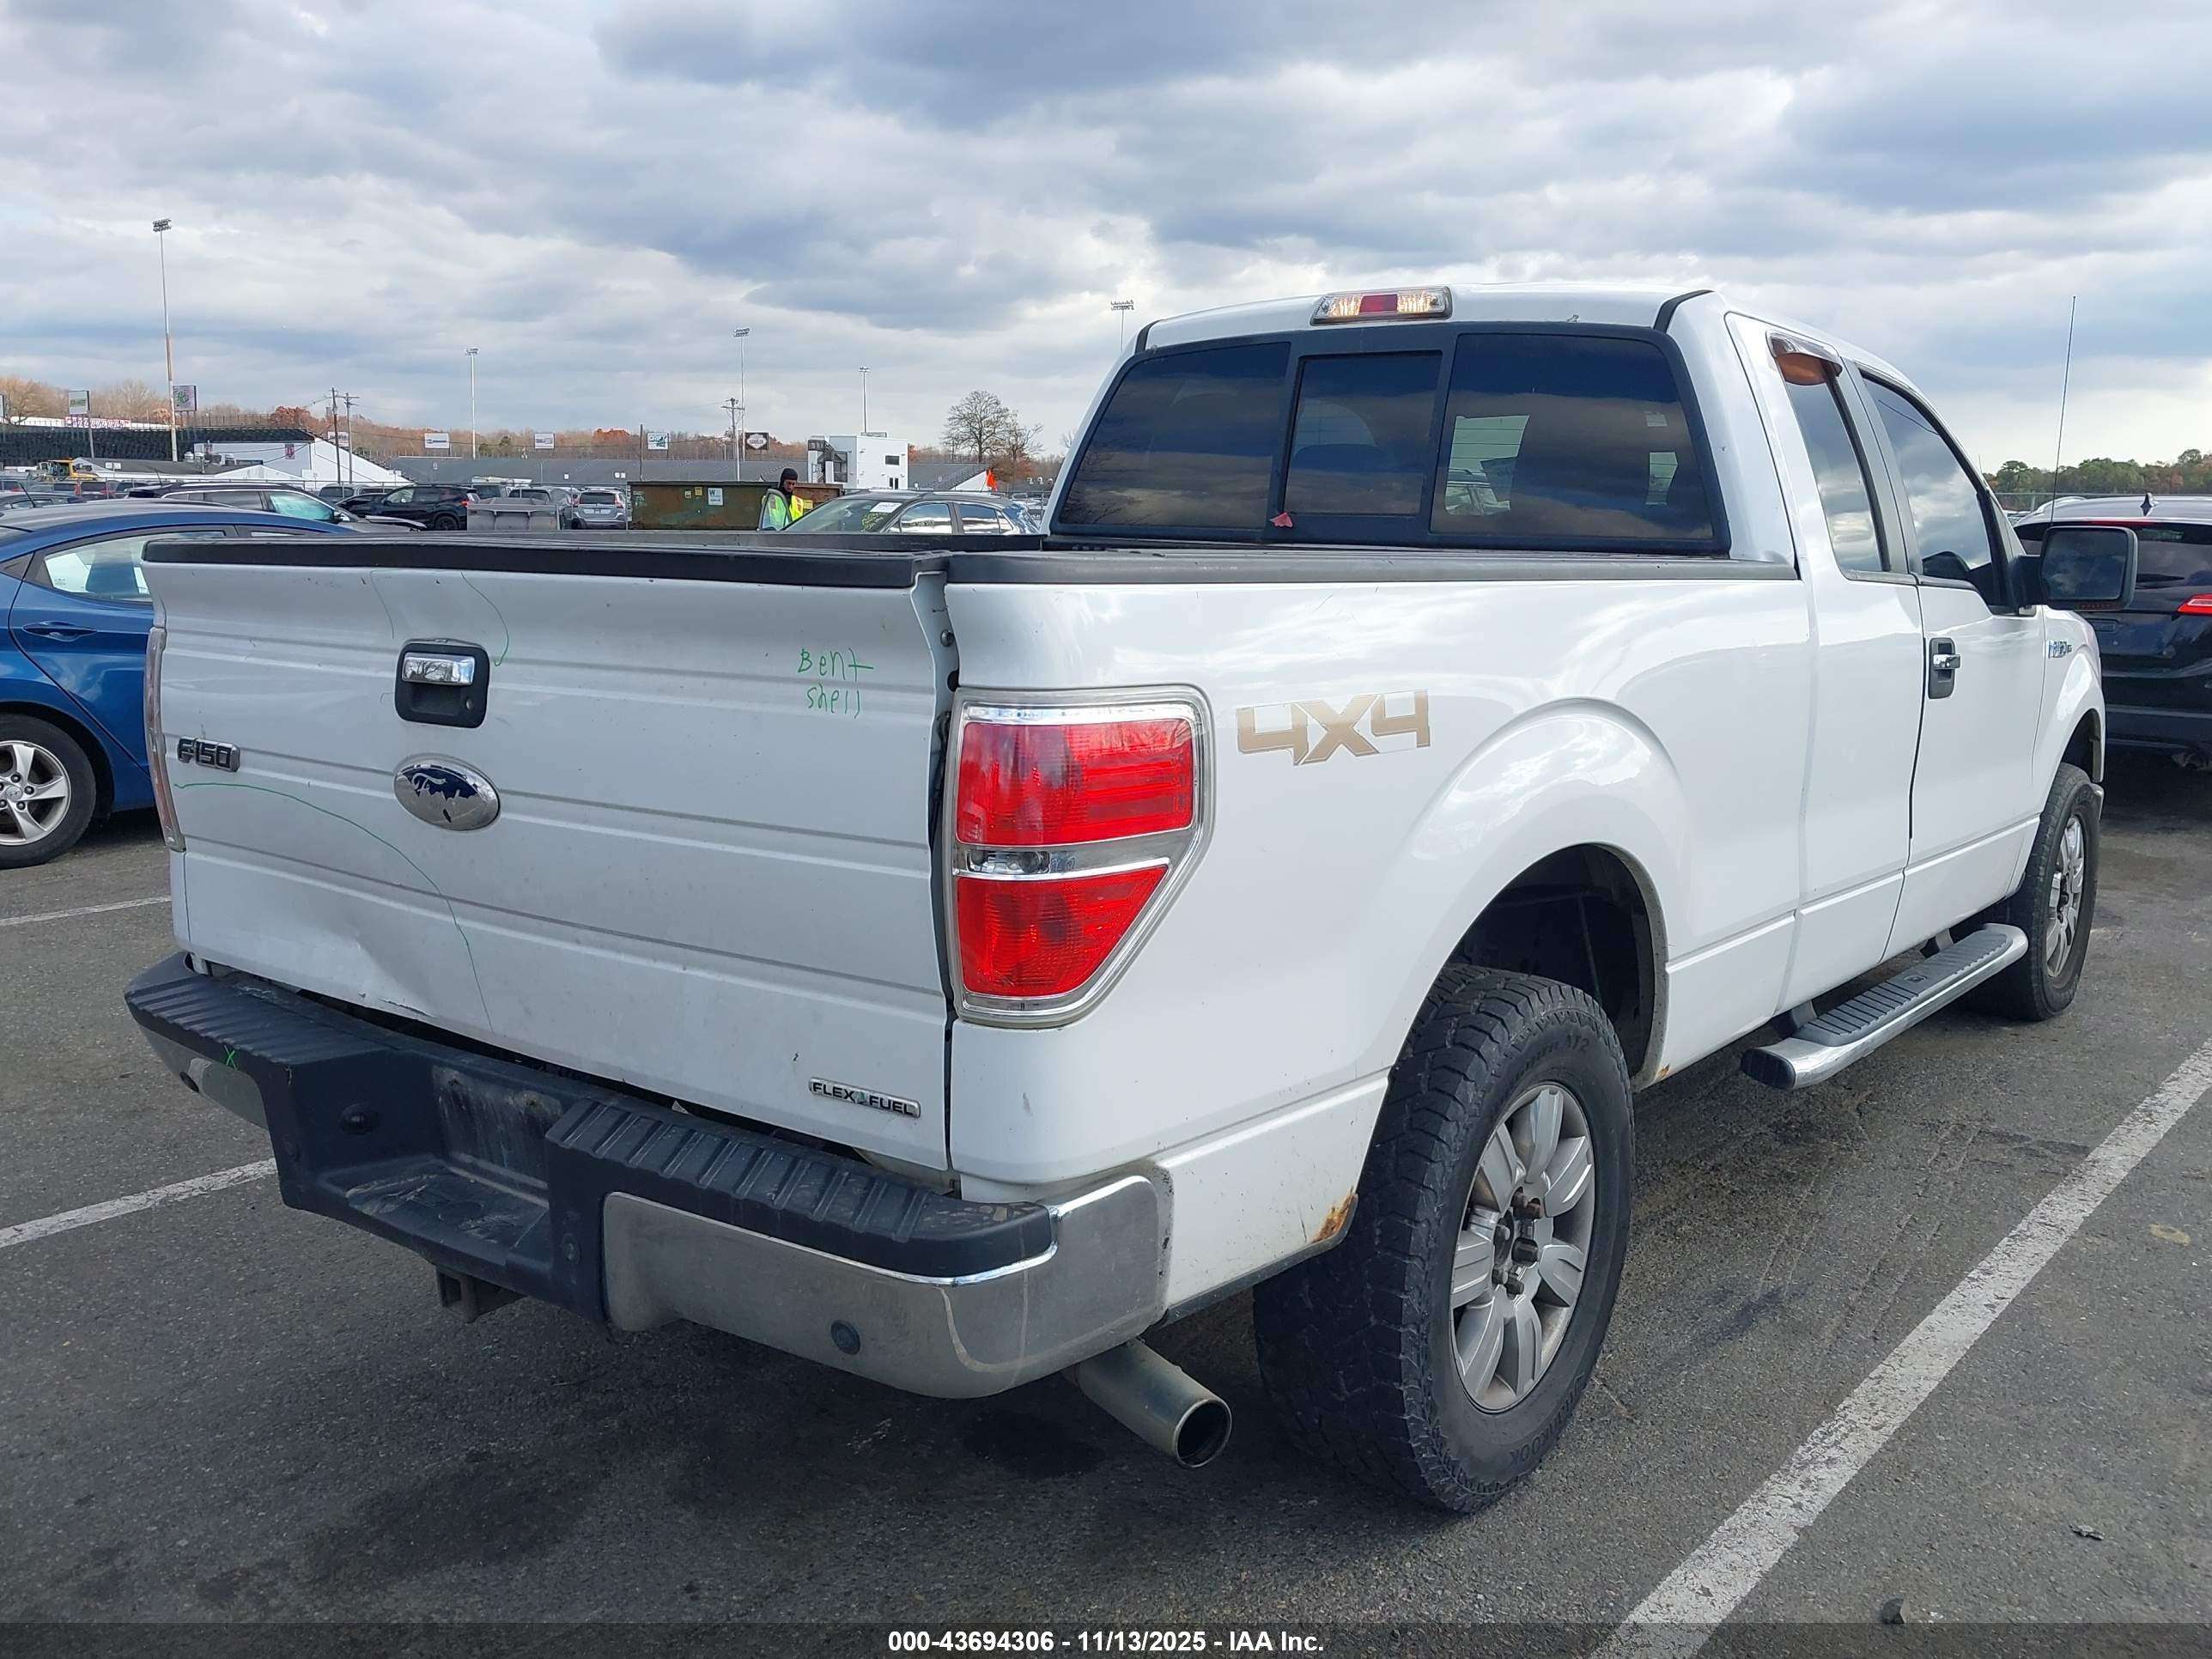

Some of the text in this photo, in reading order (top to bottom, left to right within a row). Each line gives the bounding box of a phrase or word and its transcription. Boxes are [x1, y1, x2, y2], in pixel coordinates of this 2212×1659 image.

[798, 647, 874, 683] Bent
[1236, 690, 1431, 766] 4X4
[812, 1082, 915, 1115] FLEX FUEL
